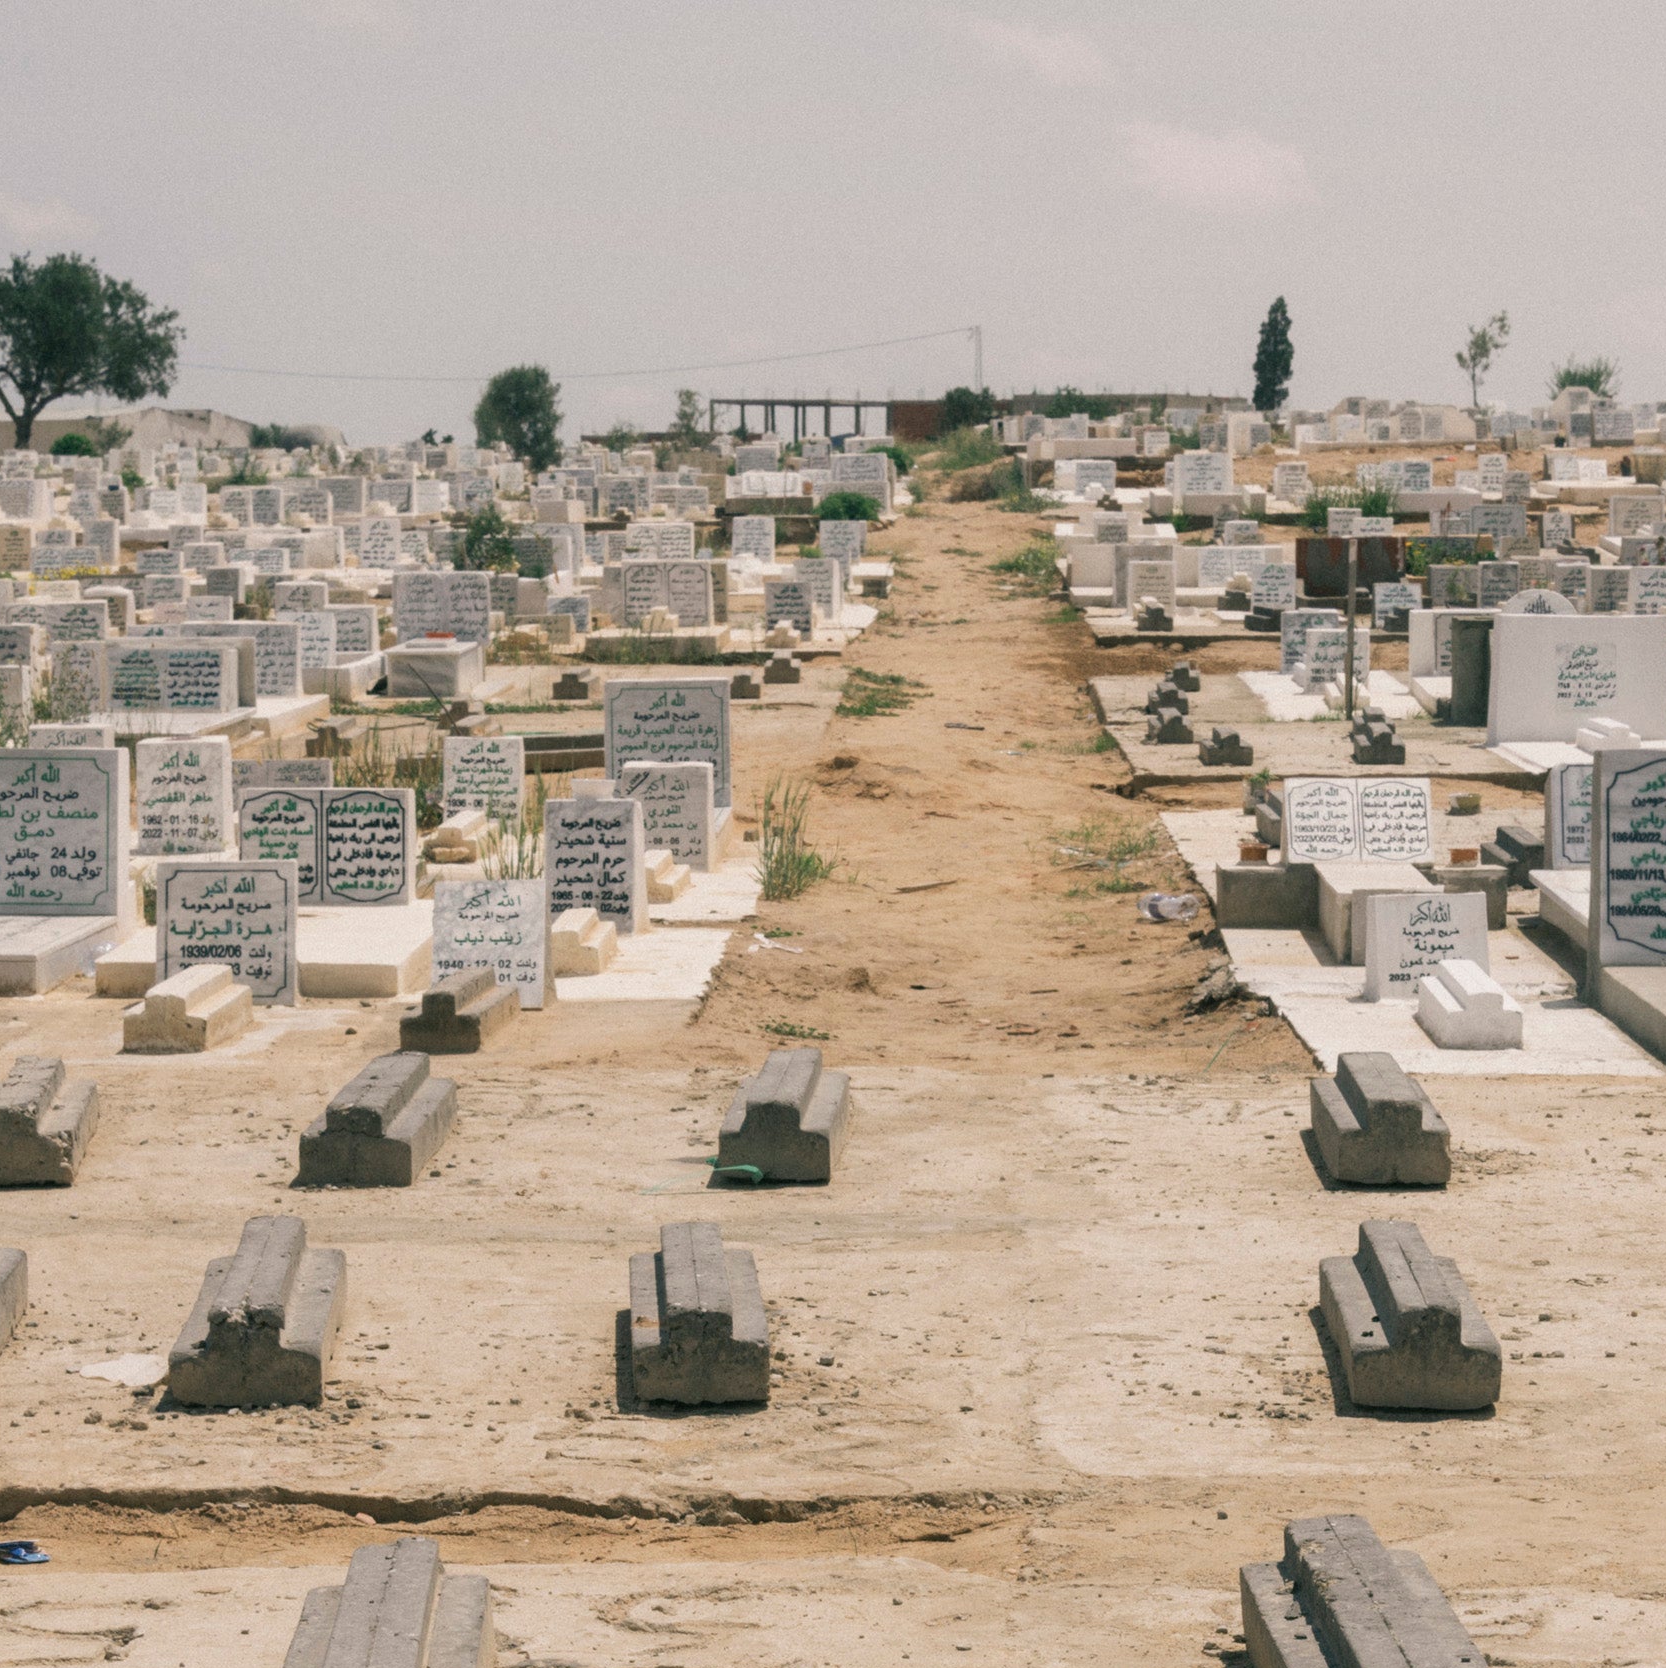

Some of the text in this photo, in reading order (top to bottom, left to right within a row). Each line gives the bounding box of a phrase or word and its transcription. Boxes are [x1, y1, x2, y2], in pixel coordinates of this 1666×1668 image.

[672, 712, 700, 720] ضريح
[158, 752, 200, 771] الله أكبر
[12, 762, 60, 786] الله أكبر
[151, 774, 207, 785] ضريح المرحوم
[43, 790, 79, 803] ضريح
[21, 809, 41, 823] بن
[47, 806, 99, 819] منصف
[561, 818, 621, 831] ضريح المرحومة
[14, 825, 55, 841] دمق
[598, 833, 627, 849] سنية
[5, 849, 39, 865] جانفي
[51, 847, 67, 859] 24
[70, 847, 97, 865] ولد
[555, 852, 626, 870] حرم المرحوم
[5, 865, 40, 880] نوفمبر
[69, 866, 102, 881] توفي
[598, 871, 626, 887] كمال
[6, 881, 63, 901] رحمه الله
[200, 876, 255, 899] الله أكبر
[181, 897, 234, 914] المرحومة
[454, 930, 523, 946] زينب ذياب
[1649, 924, 1666, 941] الله
[179, 944, 242, 959] 1939/02/06
[1414, 938, 1454, 955] ميمونة
[1389, 973, 1411, 982] 2023
